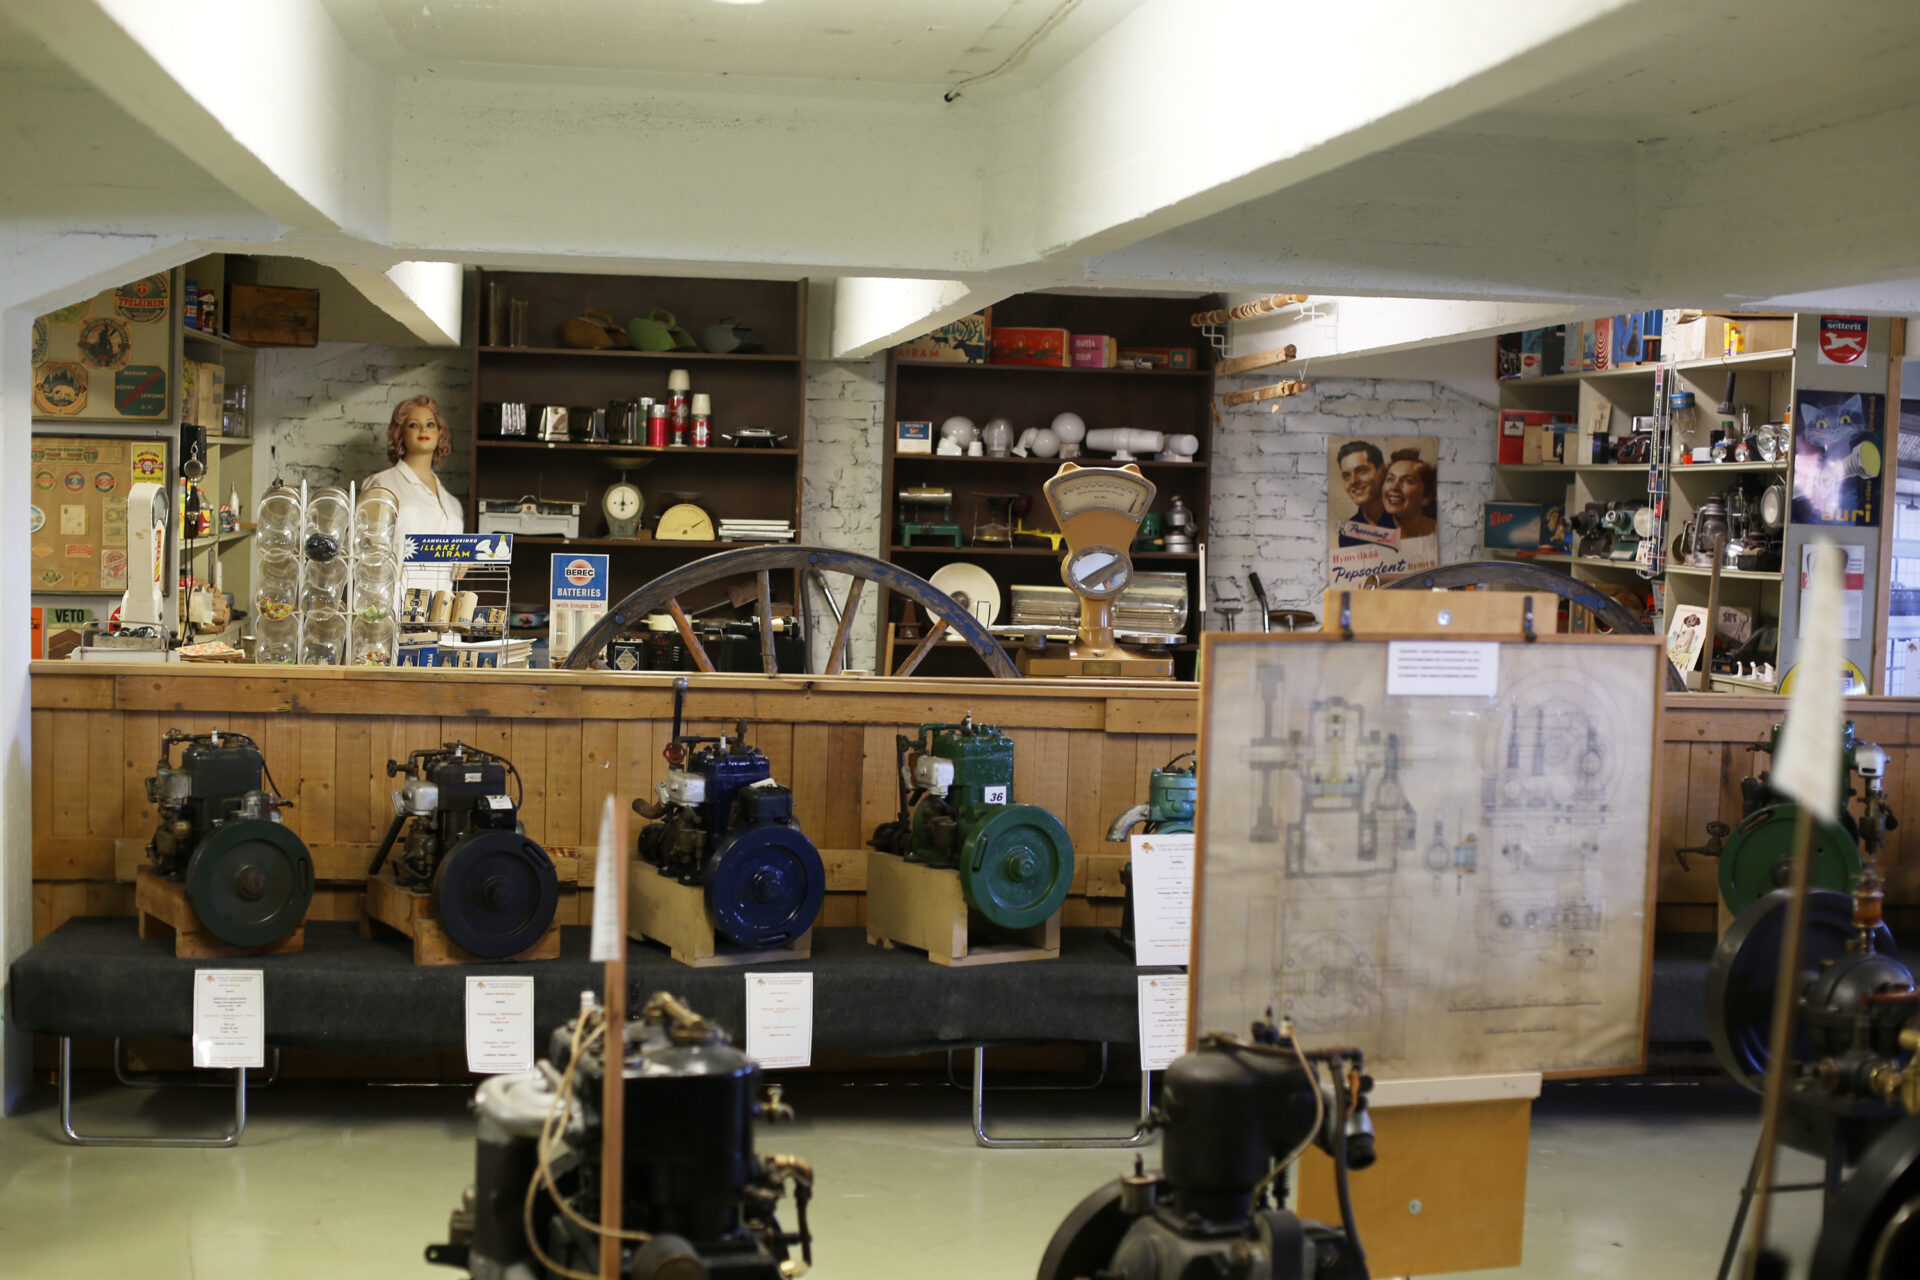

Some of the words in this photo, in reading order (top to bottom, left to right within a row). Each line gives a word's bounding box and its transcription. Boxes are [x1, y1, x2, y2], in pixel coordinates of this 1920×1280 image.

[1827, 322, 1862, 331] setterit
[897, 348, 939, 358] AIRAM
[1821, 503, 1872, 523] auri
[434, 550, 471, 558] AIRAM
[565, 569, 594, 577] BEREC
[1332, 558, 1407, 583] Pepsodent
[557, 587, 601, 597] BATTERIES
[570, 602, 589, 610] longer
[55, 608, 84, 622] VETO
[989, 792, 1004, 802] 36
